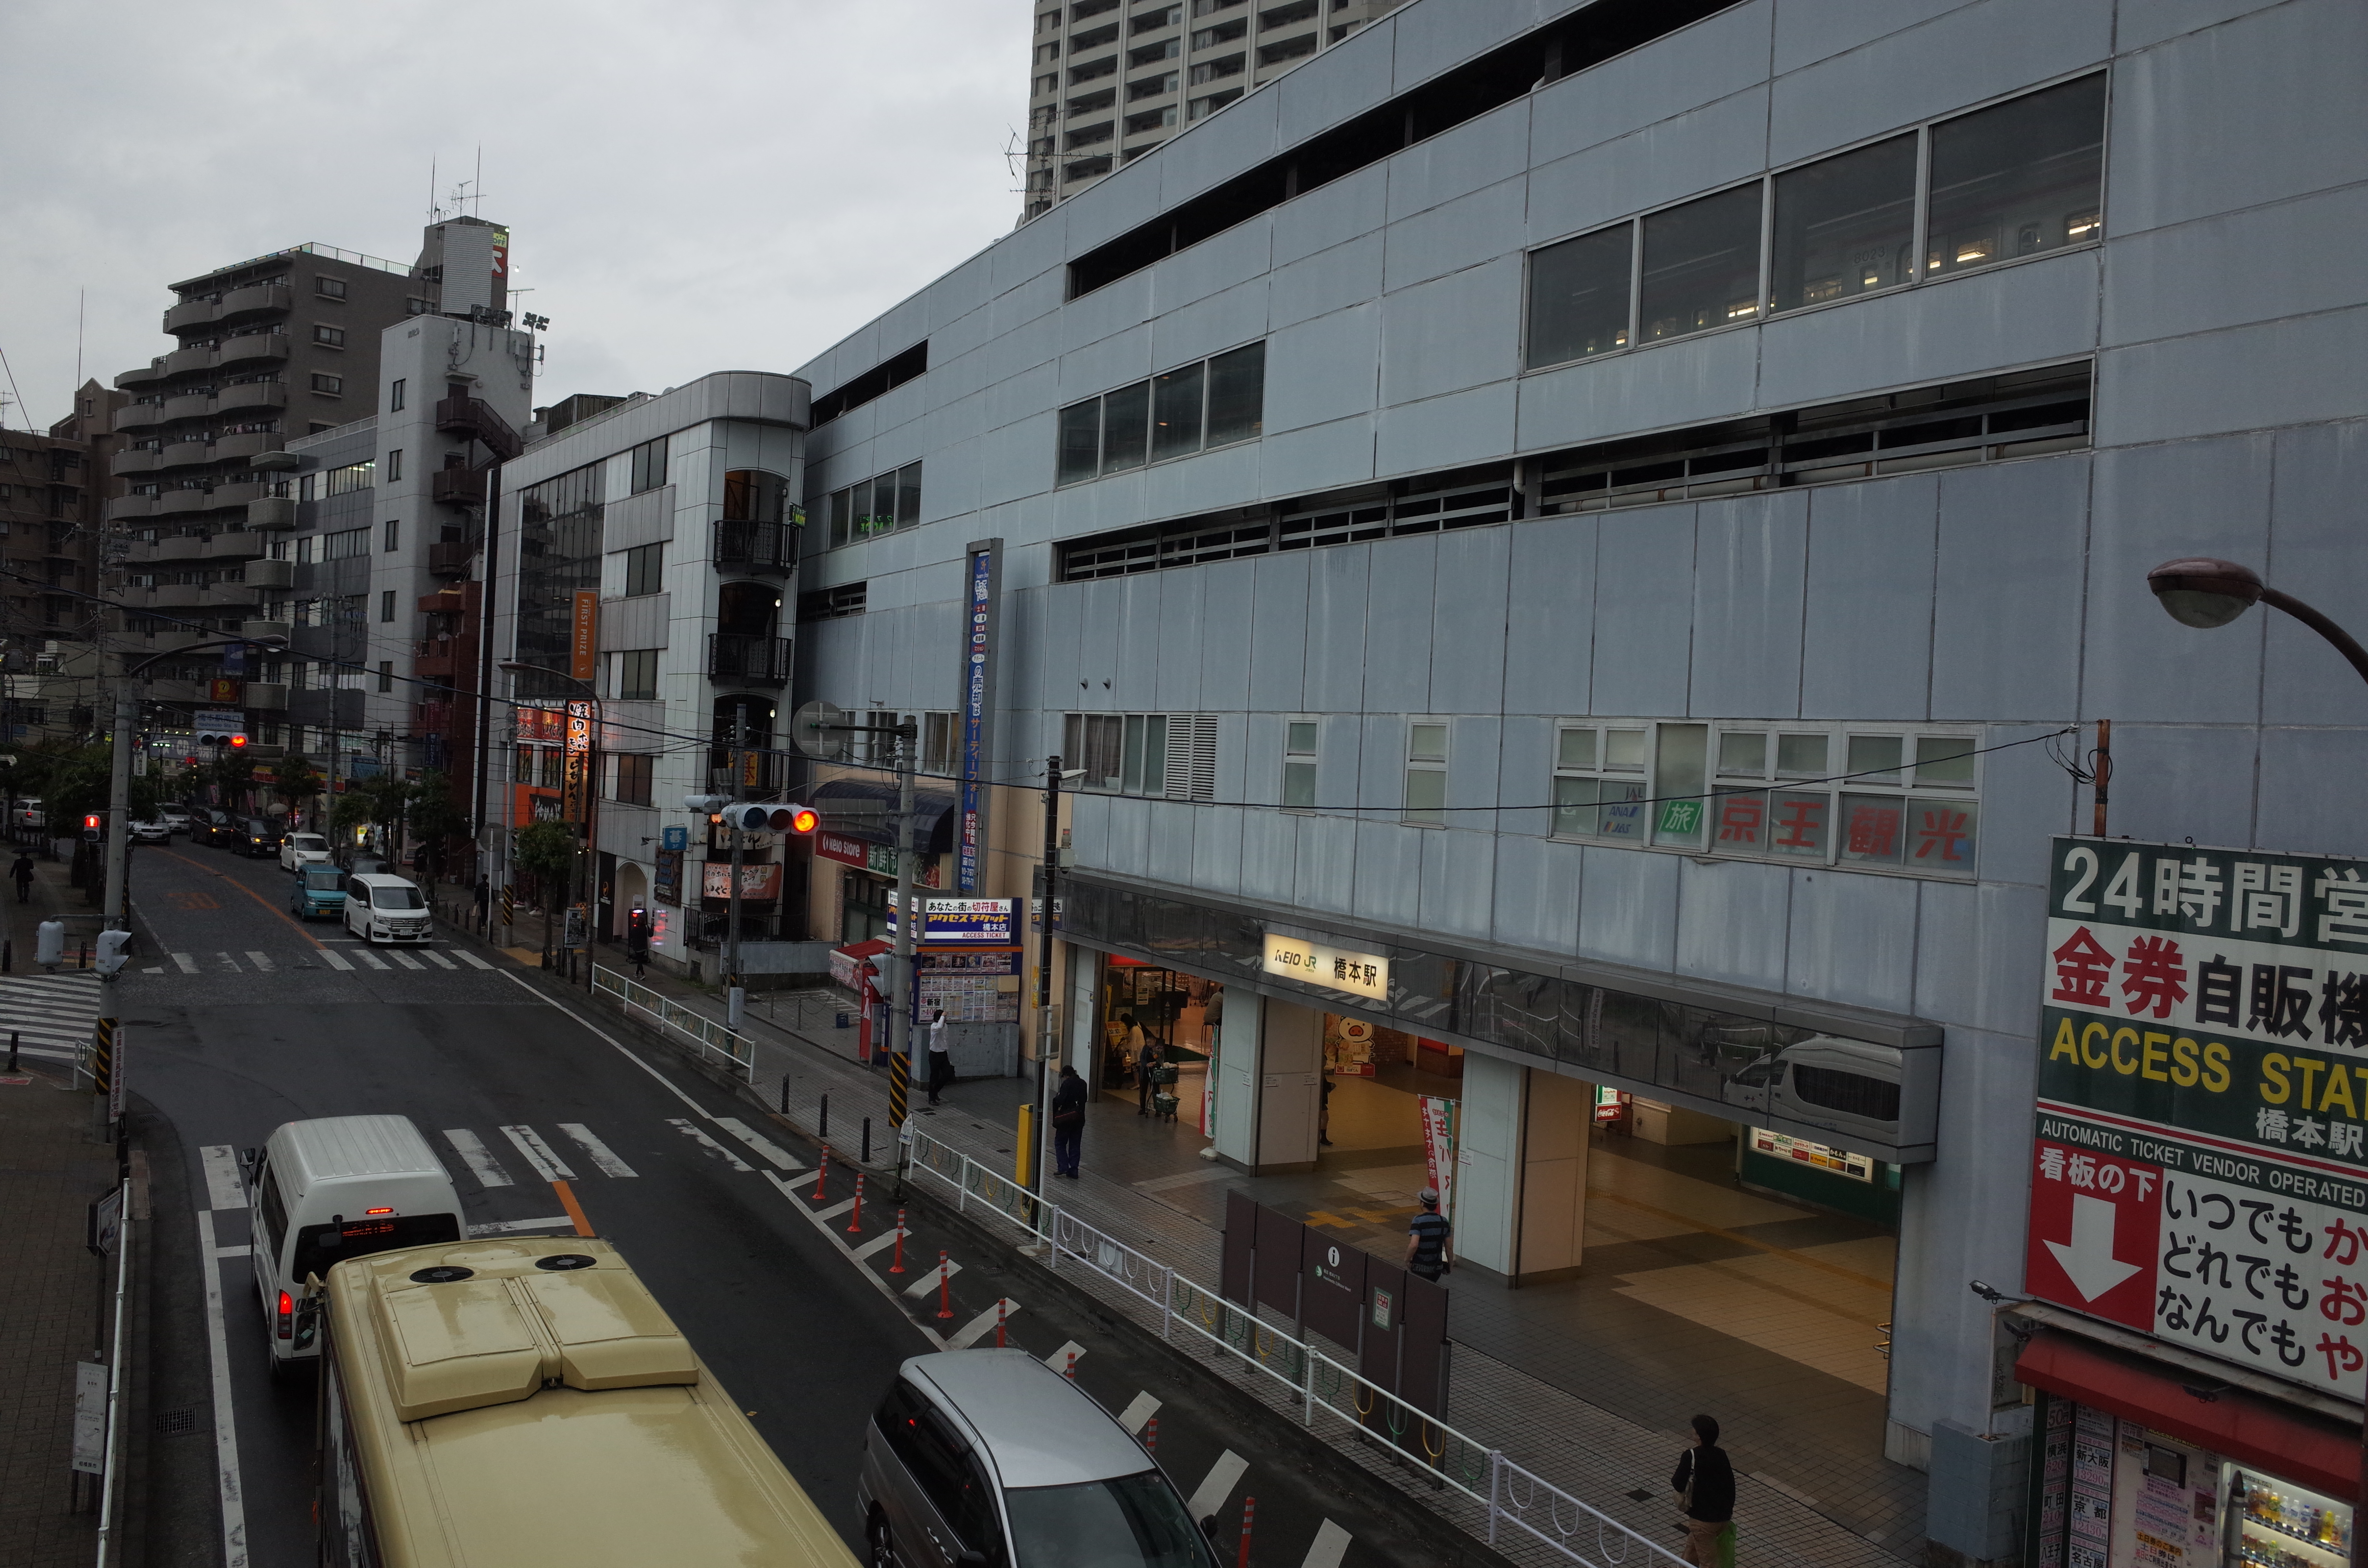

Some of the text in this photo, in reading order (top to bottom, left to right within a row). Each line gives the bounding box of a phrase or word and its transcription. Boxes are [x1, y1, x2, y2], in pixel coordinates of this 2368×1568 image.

[579, 629, 587, 656] PRIZE
[1626, 786, 1644, 801] JAL
[1609, 807, 1630, 818] ANA
[1665, 804, 1692, 832] 旅
[1719, 796, 1967, 861] 京王観光
[2061, 846, 2368, 943] 24時間営
[928, 901, 1009, 913] あなたの街の切符屋さん
[927, 914, 1009, 923] アクセス チケット
[982, 922, 1007, 931] 橋本店
[1275, 949, 1317, 969] KEIO JR
[1334, 956, 1377, 988] 橋本駅
[927, 998, 941, 1006] 新宿
[2049, 1017, 2231, 1093] ACCESS
[2255, 1107, 2365, 1160] 橋本駅
[2042, 1119, 2366, 1208] AUTOMATIC TICKET VENDOR OPERATED
[2039, 1147, 2157, 1202] 看板の下
[2047, 1442, 2066, 1458] 横浜
[2075, 1449, 2109, 1469] 新大阪
[2074, 1468, 2109, 1488] 13290円
[2043, 1492, 2063, 1508] 町田
[2073, 1500, 2107, 1520] 京都
[2072, 1519, 2107, 1540] 12430円
[2040, 1543, 2060, 1561] 八王子
